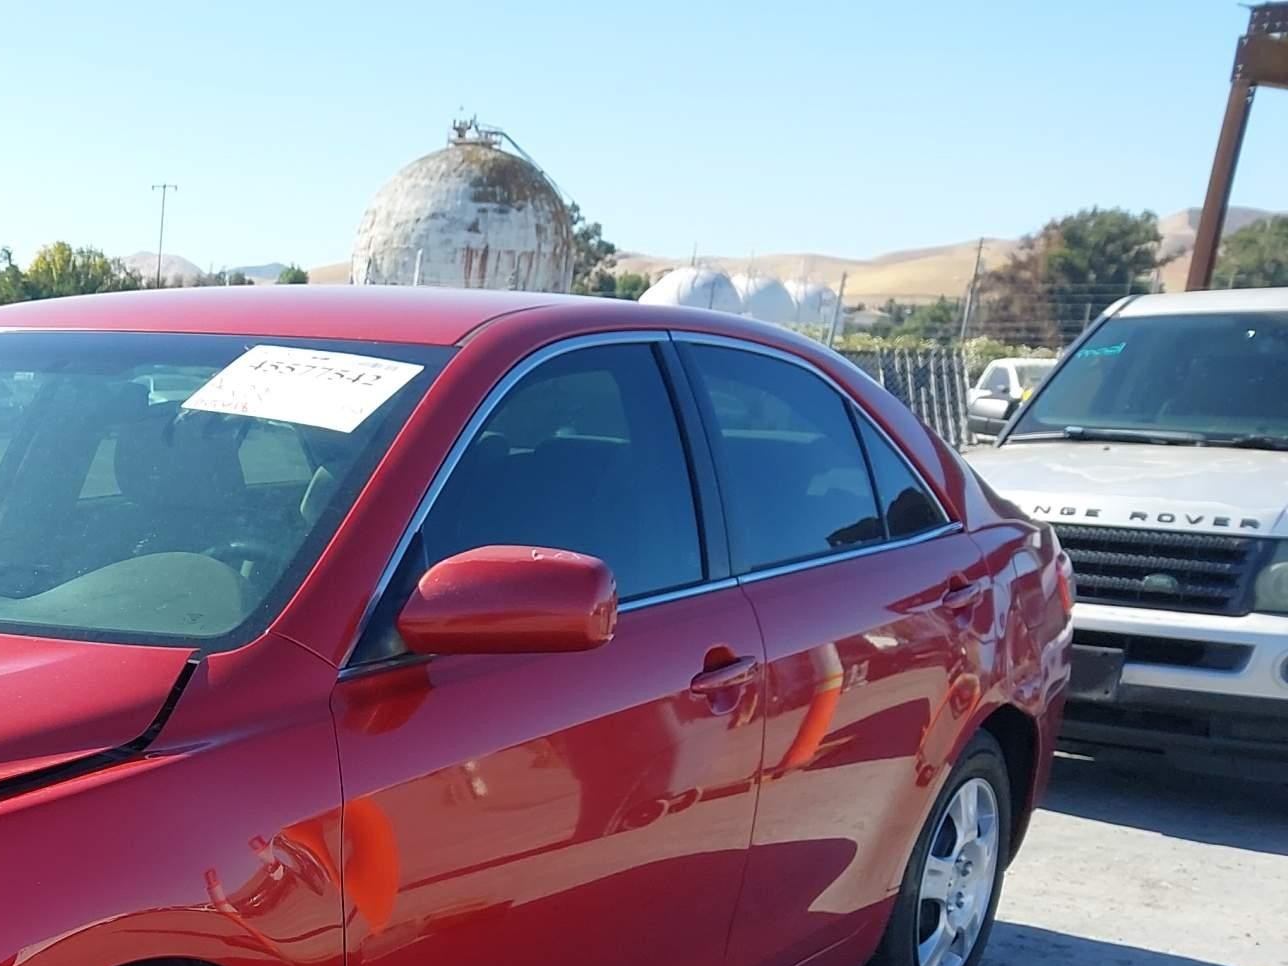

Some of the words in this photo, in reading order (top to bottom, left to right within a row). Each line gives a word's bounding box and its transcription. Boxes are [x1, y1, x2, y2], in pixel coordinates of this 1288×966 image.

[248, 360, 383, 387] 45577542
[1032, 504, 1103, 518] NGE
[1128, 510, 1262, 530] ROVER
